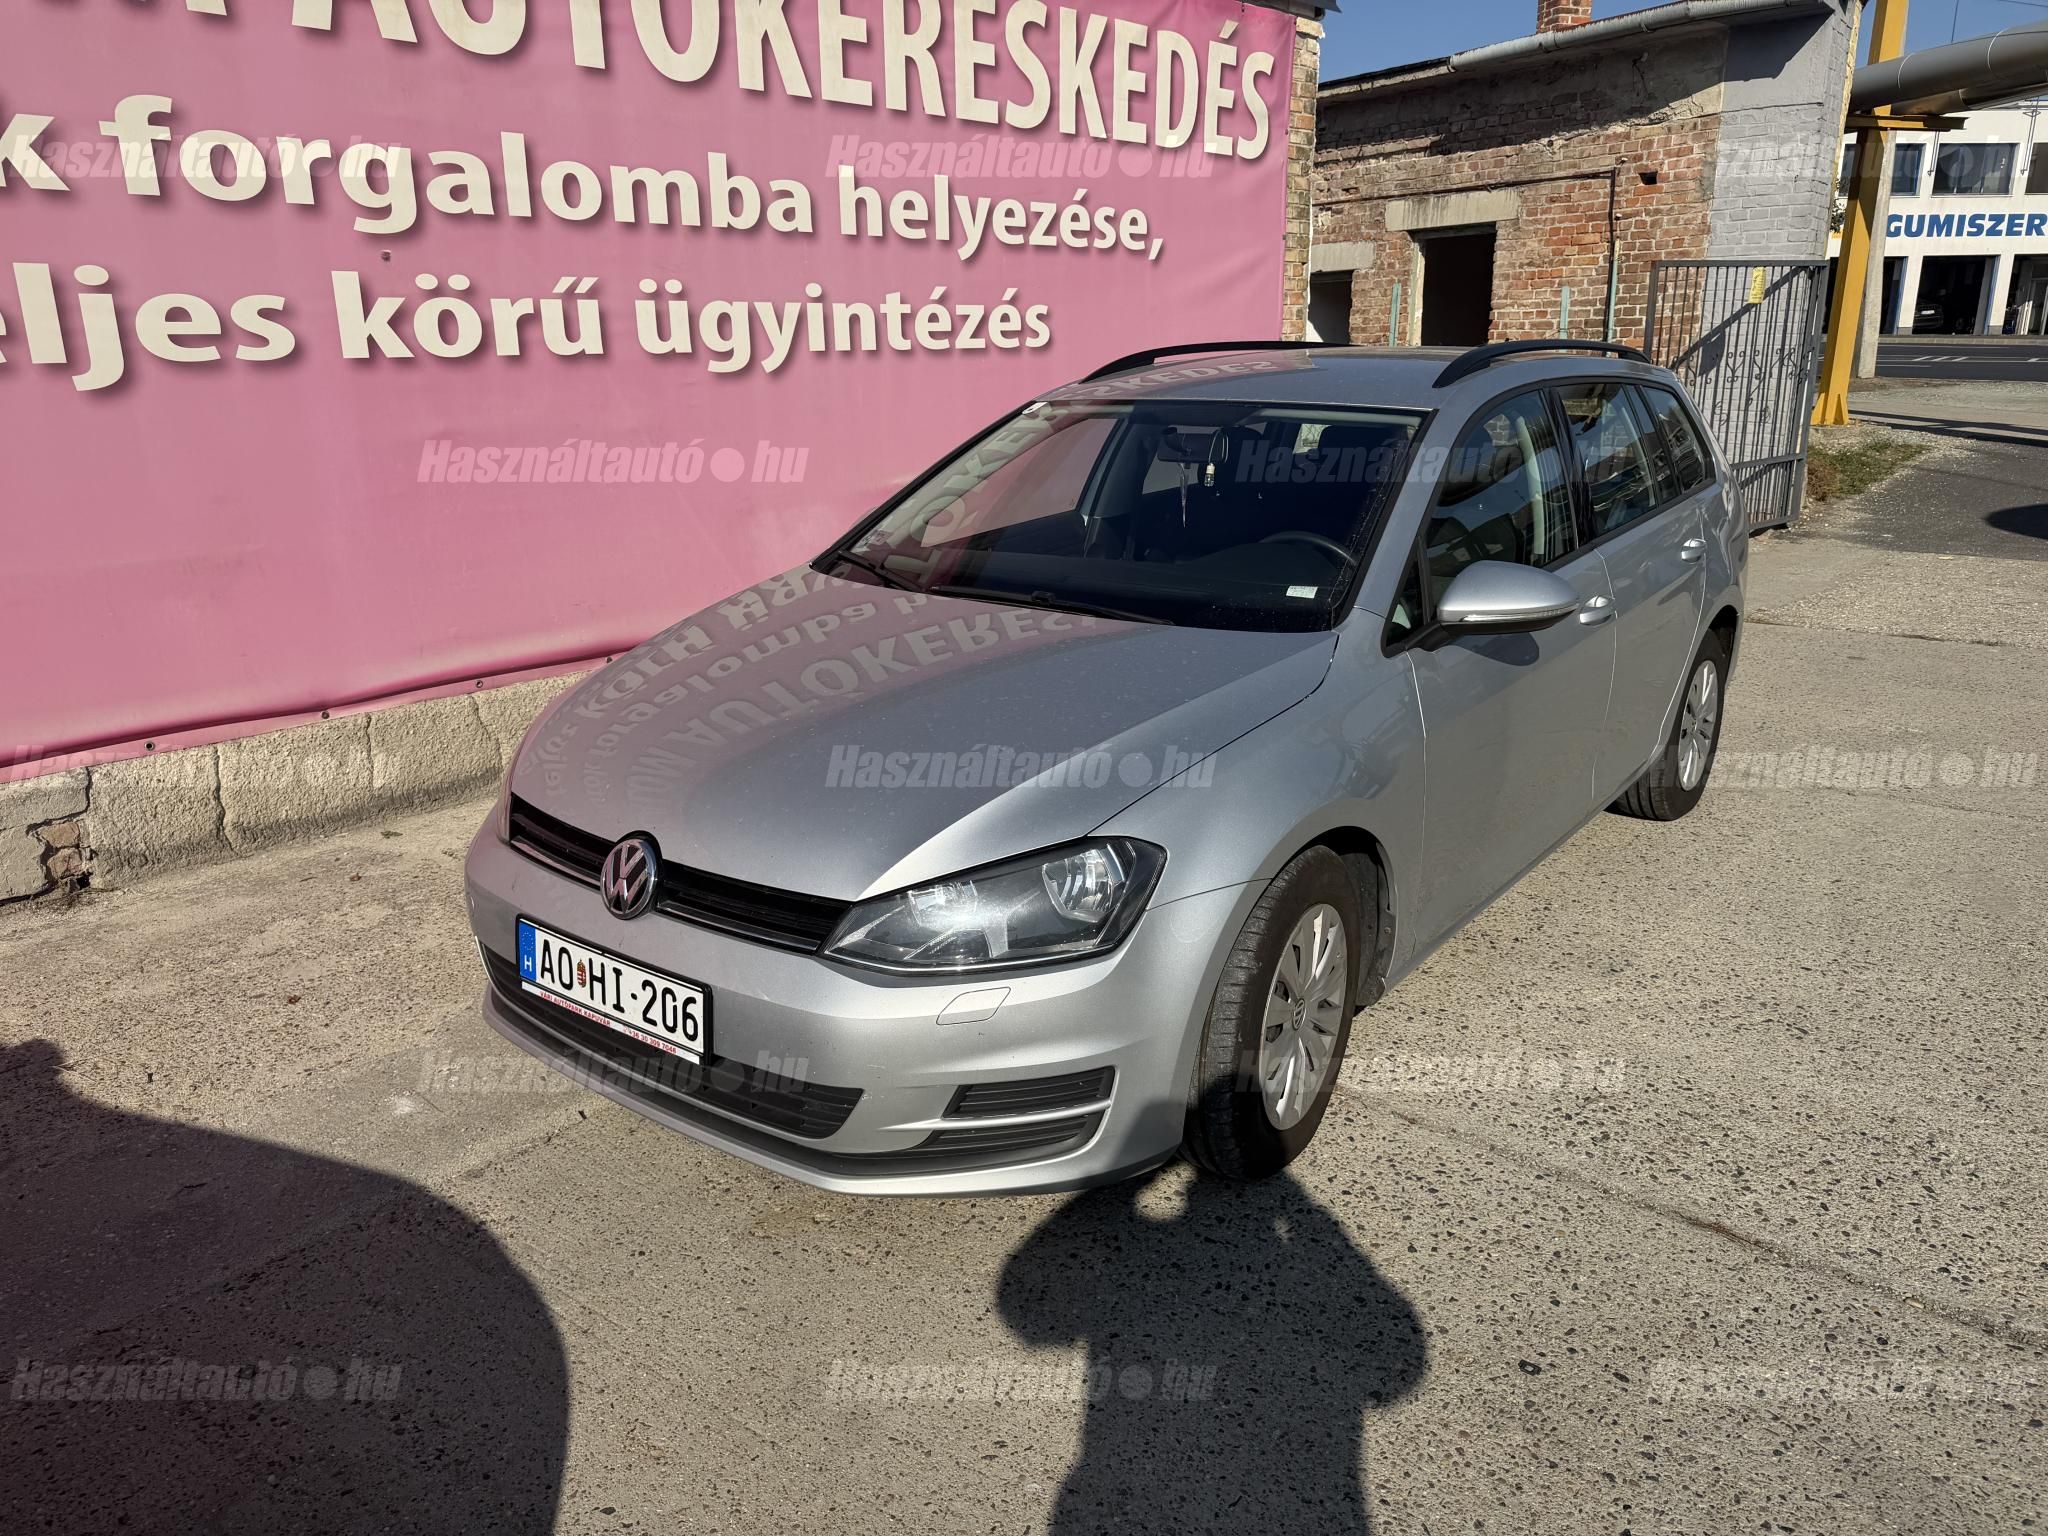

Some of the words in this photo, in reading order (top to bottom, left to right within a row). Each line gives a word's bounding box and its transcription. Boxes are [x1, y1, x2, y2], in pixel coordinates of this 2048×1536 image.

[292, 0, 1275, 160] KERESKEDÉS
[99, 94, 814, 234] forgalomba
[838, 165, 1165, 261] helyezése,
[1886, 213, 2047, 238] GUMISZER
[0, 262, 297, 392] ljes
[331, 270, 604, 360] körű
[636, 278, 1052, 374] ügyintézés
[523, 954, 533, 973] H
[540, 938, 574, 991] AO
